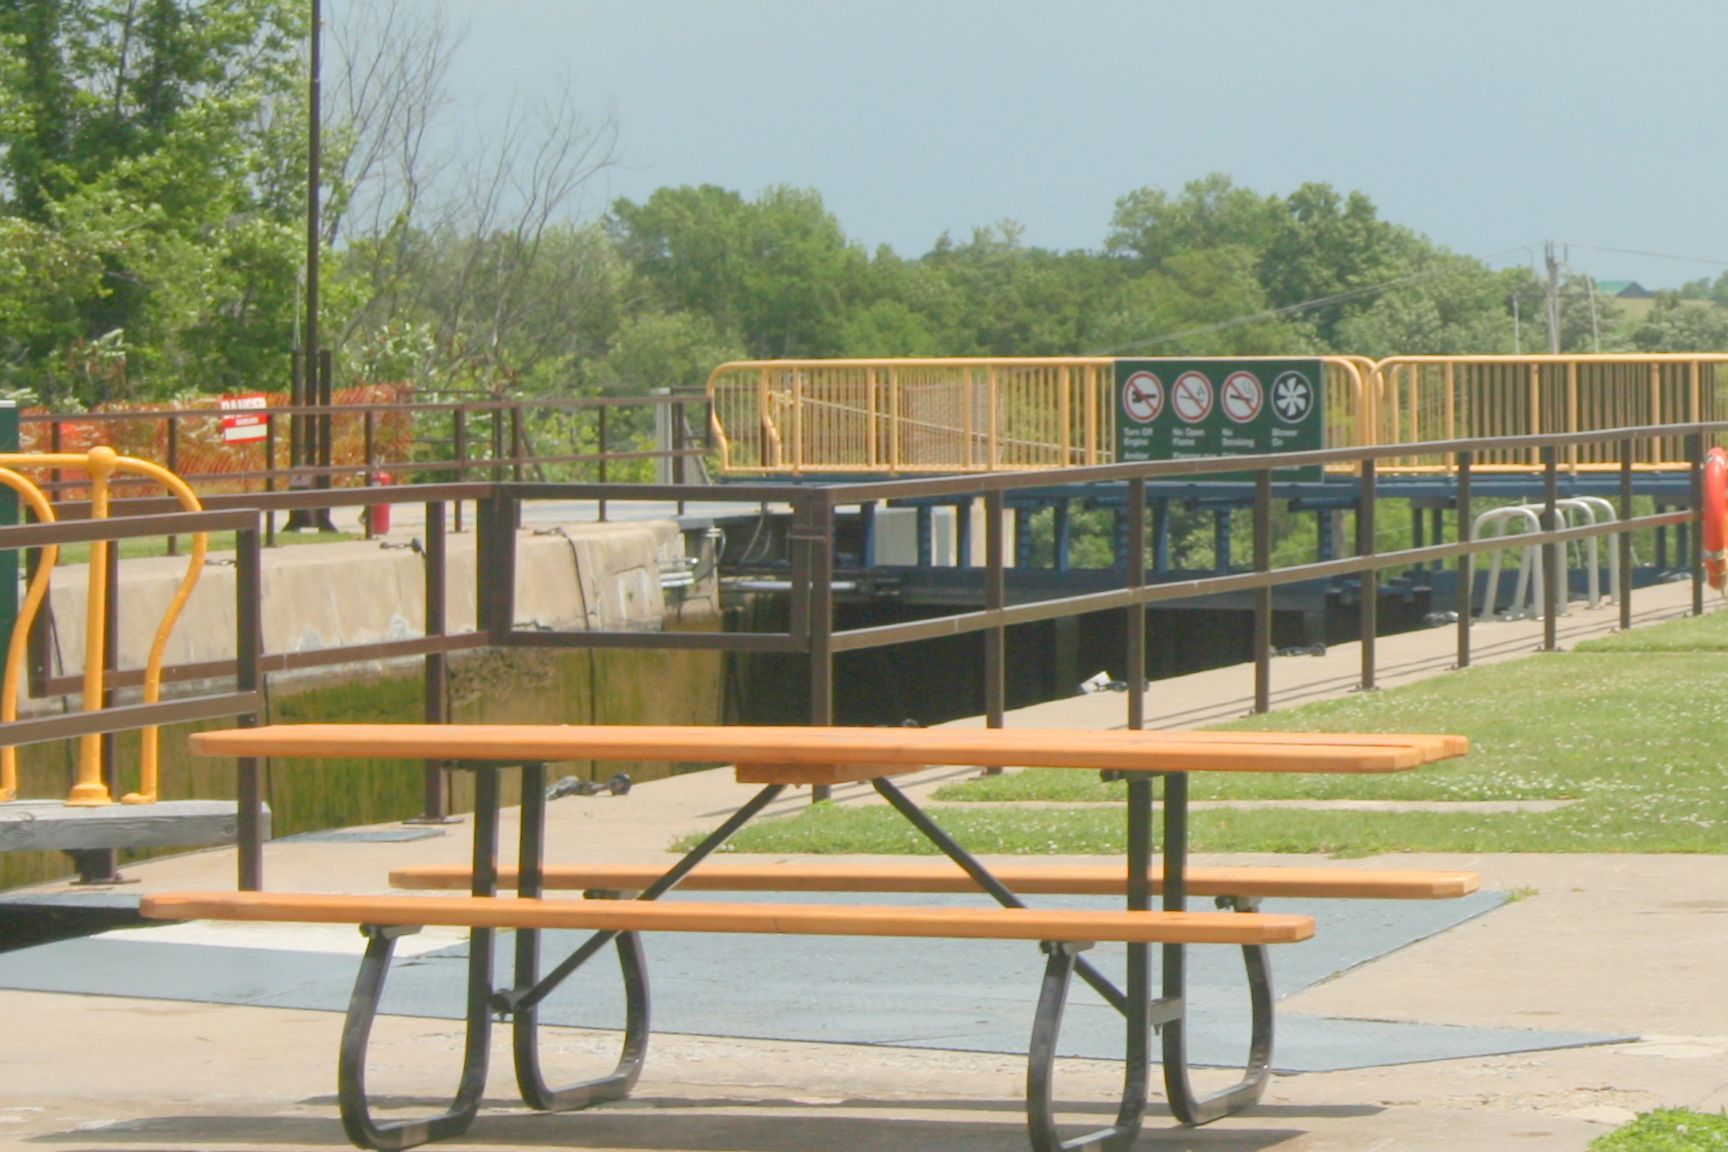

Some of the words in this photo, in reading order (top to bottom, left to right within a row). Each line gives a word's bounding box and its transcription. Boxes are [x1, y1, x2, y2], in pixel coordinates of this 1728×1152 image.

[221, 397, 267, 419] DANGER
[1123, 427, 1140, 437] Turn
[1141, 427, 1154, 437] Off
[1172, 427, 1184, 437] No
[1185, 427, 1206, 438] Open
[1222, 427, 1234, 437] No
[1271, 427, 1299, 437] Blower
[1123, 437, 1149, 448] Engine
[1172, 437, 1196, 447] Flame
[1222, 437, 1255, 449] Smoking
[1271, 437, 1284, 447] On
